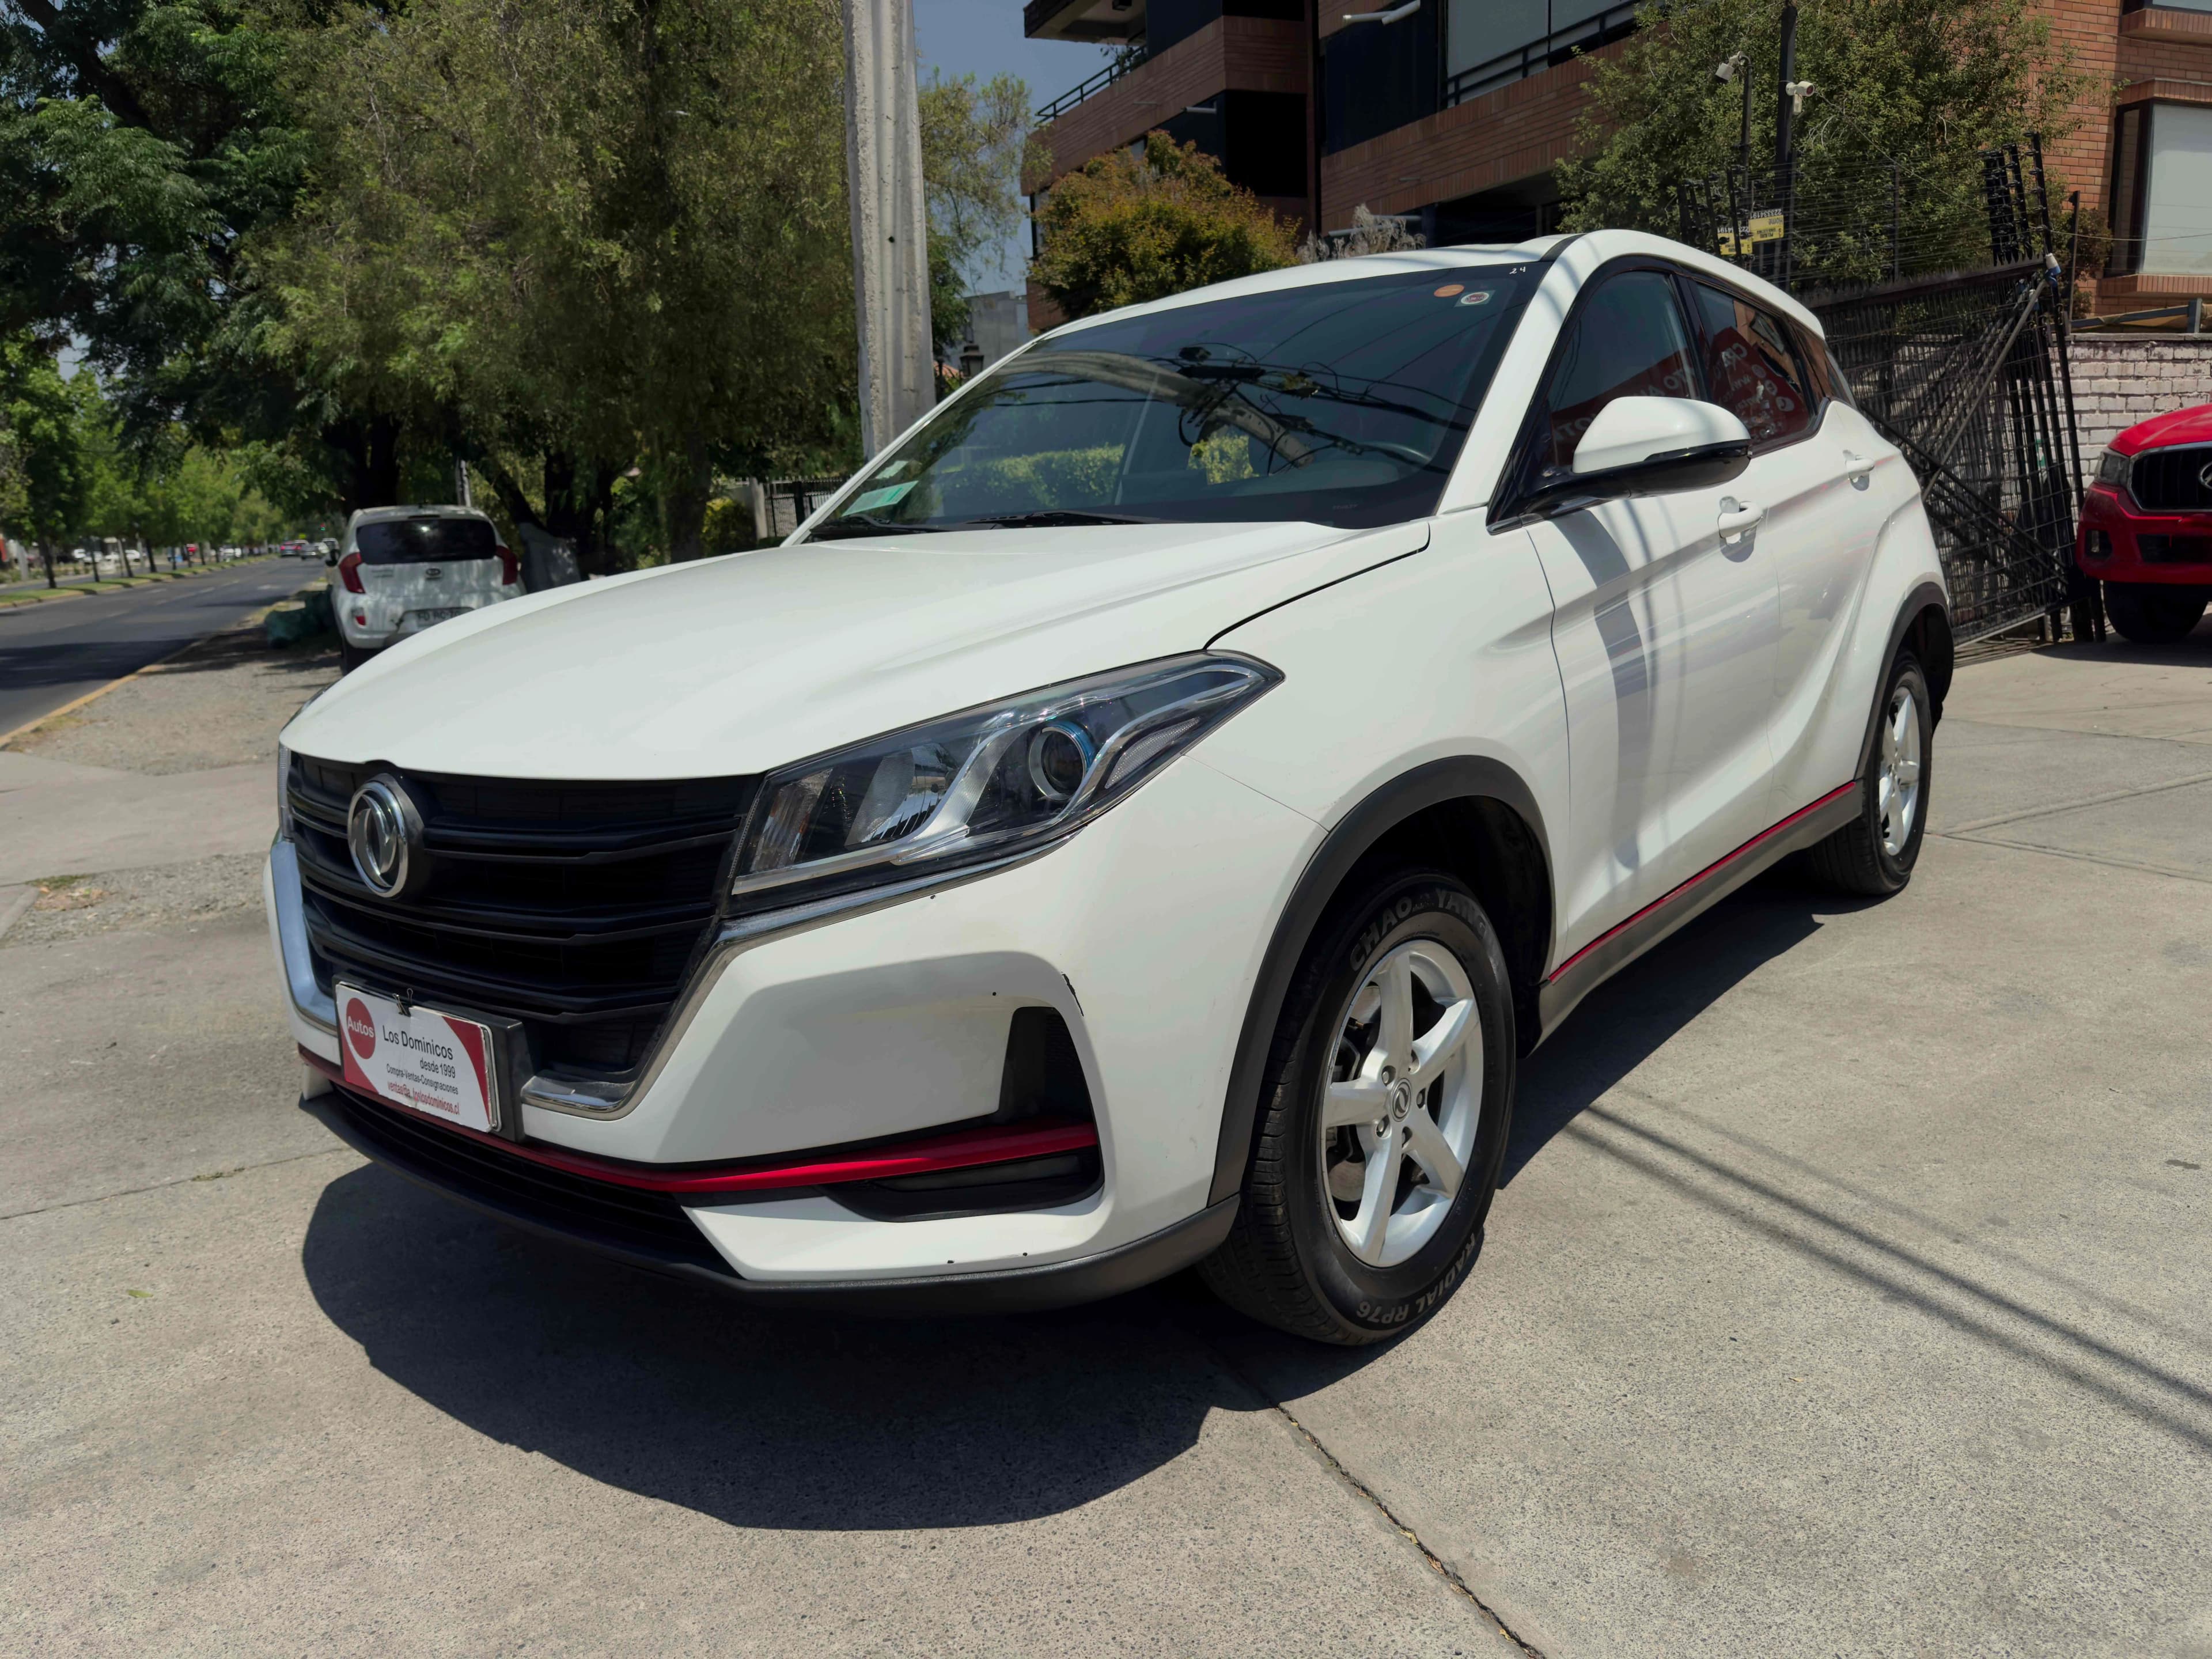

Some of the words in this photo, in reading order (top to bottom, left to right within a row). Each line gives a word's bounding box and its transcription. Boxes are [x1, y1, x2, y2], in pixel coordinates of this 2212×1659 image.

[1350, 896, 1412, 972] CHAO
[347, 1016, 374, 1037] Autos
[382, 1025, 399, 1044] Los
[401, 1031, 453, 1060] Dominicos
[420, 1058, 439, 1074] desde
[440, 1063, 456, 1078] 1999
[388, 1081, 460, 1115] ventas@atoslosdominicos.cl
[1415, 1232, 1475, 1313] RADIAL
[1355, 1300, 1410, 1324] RP76
